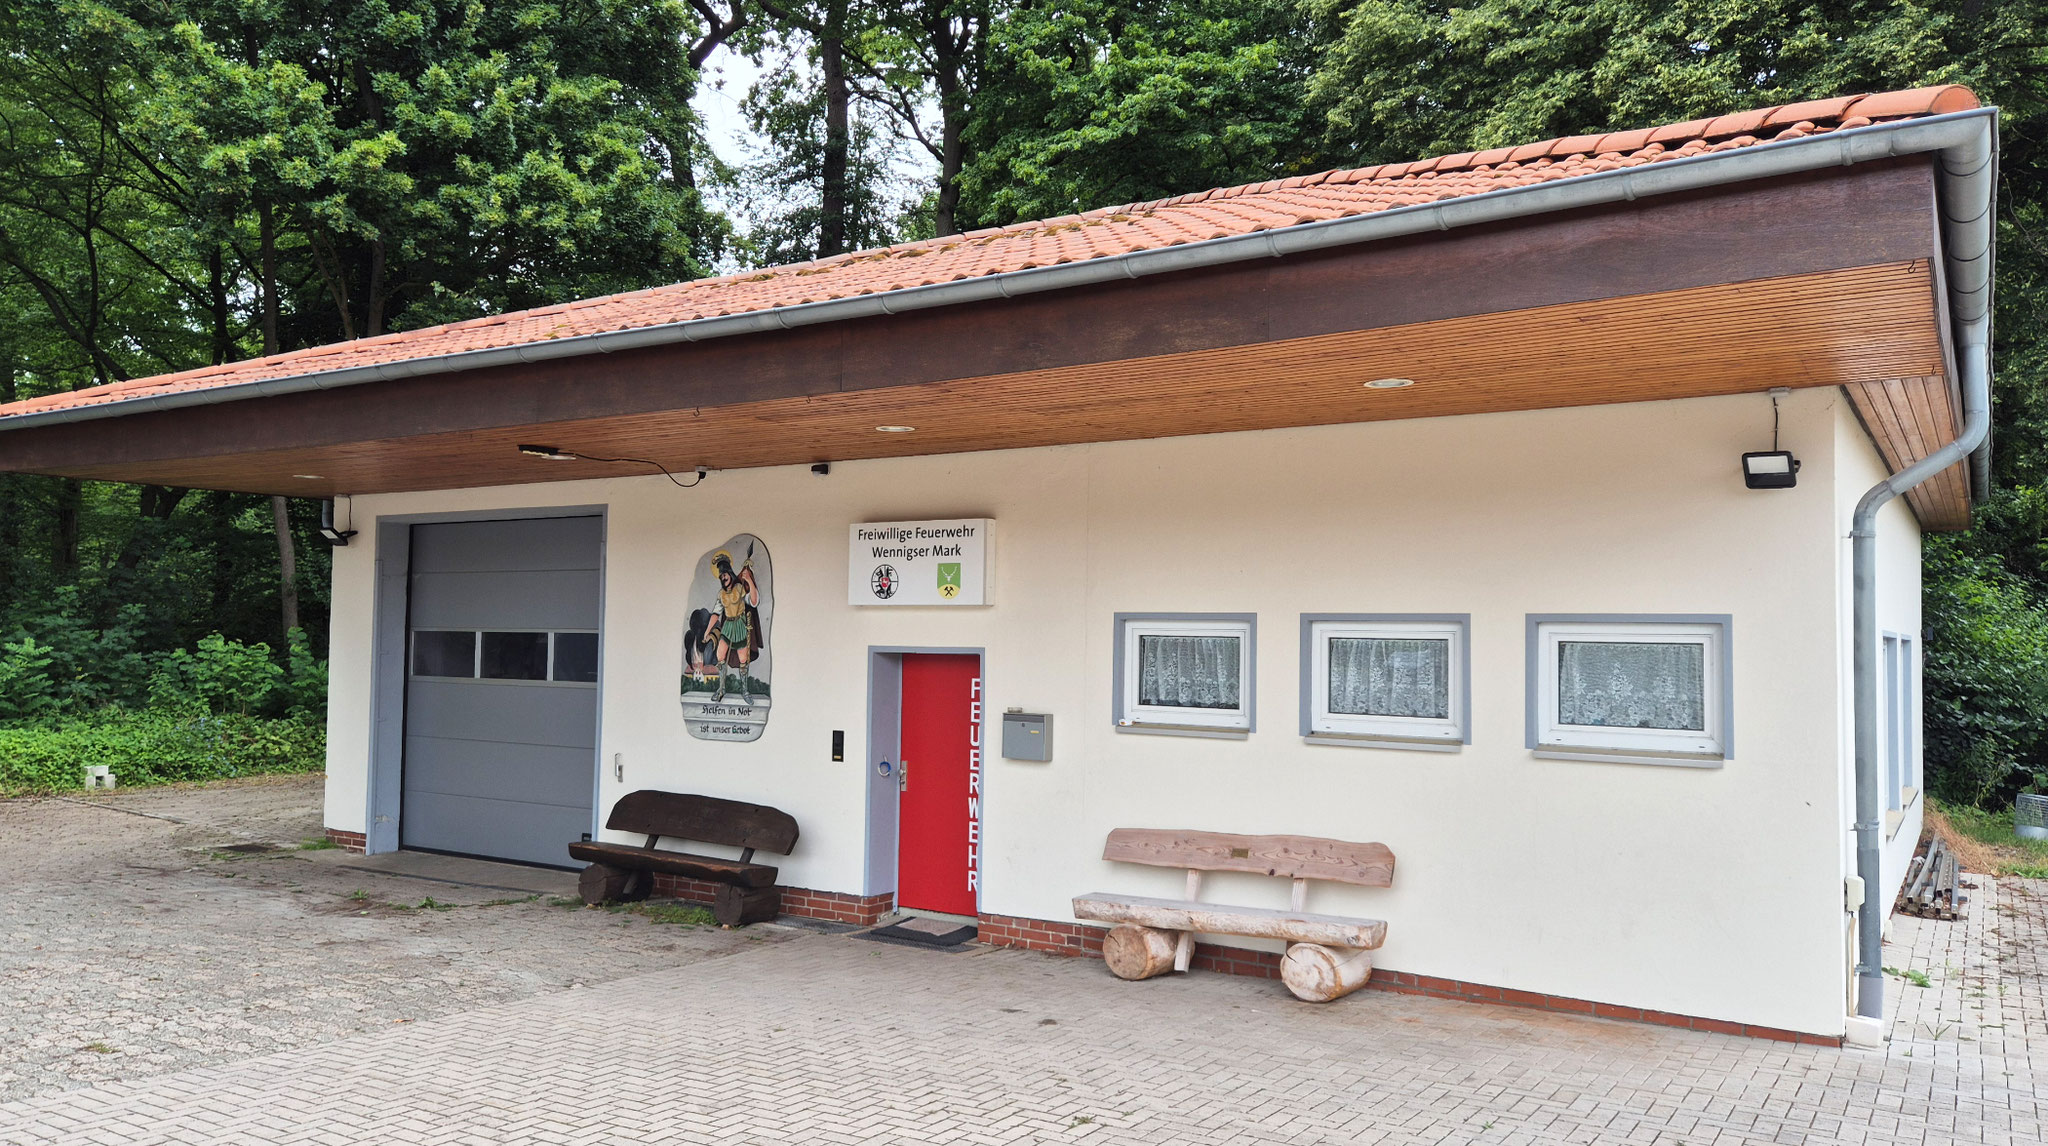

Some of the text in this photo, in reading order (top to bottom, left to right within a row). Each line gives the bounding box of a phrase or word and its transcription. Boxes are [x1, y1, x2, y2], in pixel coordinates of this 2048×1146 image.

[858, 524, 975, 543] Freiwillige Feuerwehr
[872, 544, 962, 561] Wennigser Mark
[701, 704, 752, 717] Helfen in Not
[700, 722, 710, 734] ist
[712, 726, 731, 734] unser
[967, 678, 981, 892] FEUERWEHR
